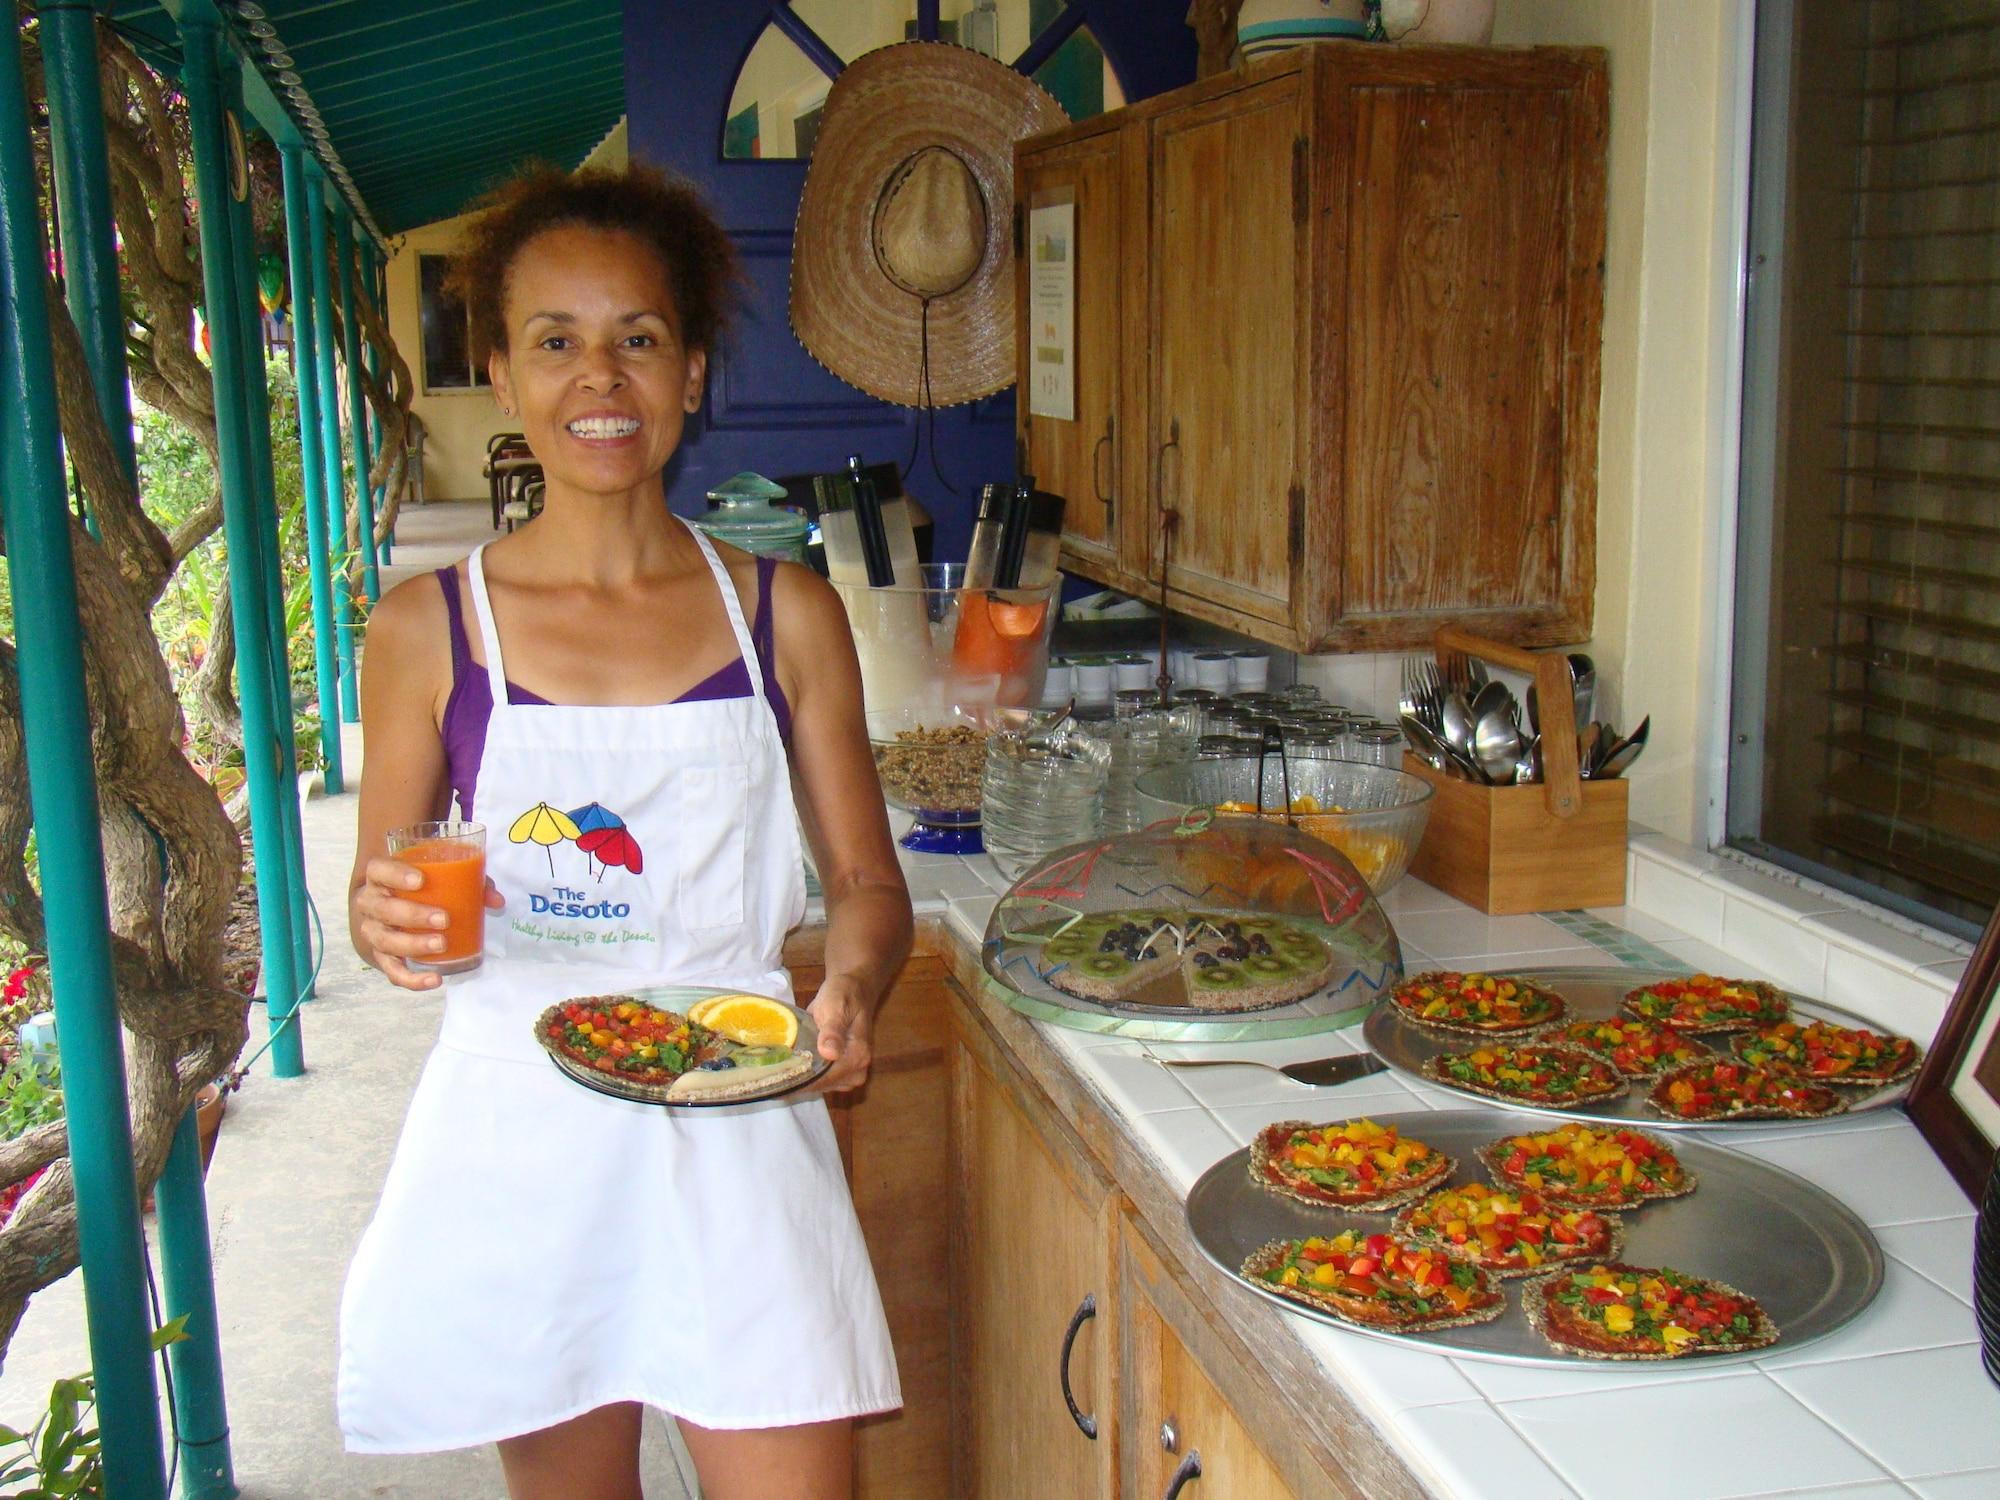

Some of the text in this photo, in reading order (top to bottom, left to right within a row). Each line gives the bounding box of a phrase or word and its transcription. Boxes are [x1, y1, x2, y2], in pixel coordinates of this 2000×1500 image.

[553, 887, 586, 901] The
[528, 893, 630, 919] Desoto
[583, 931, 597, 944] @
[601, 931, 618, 944] the
